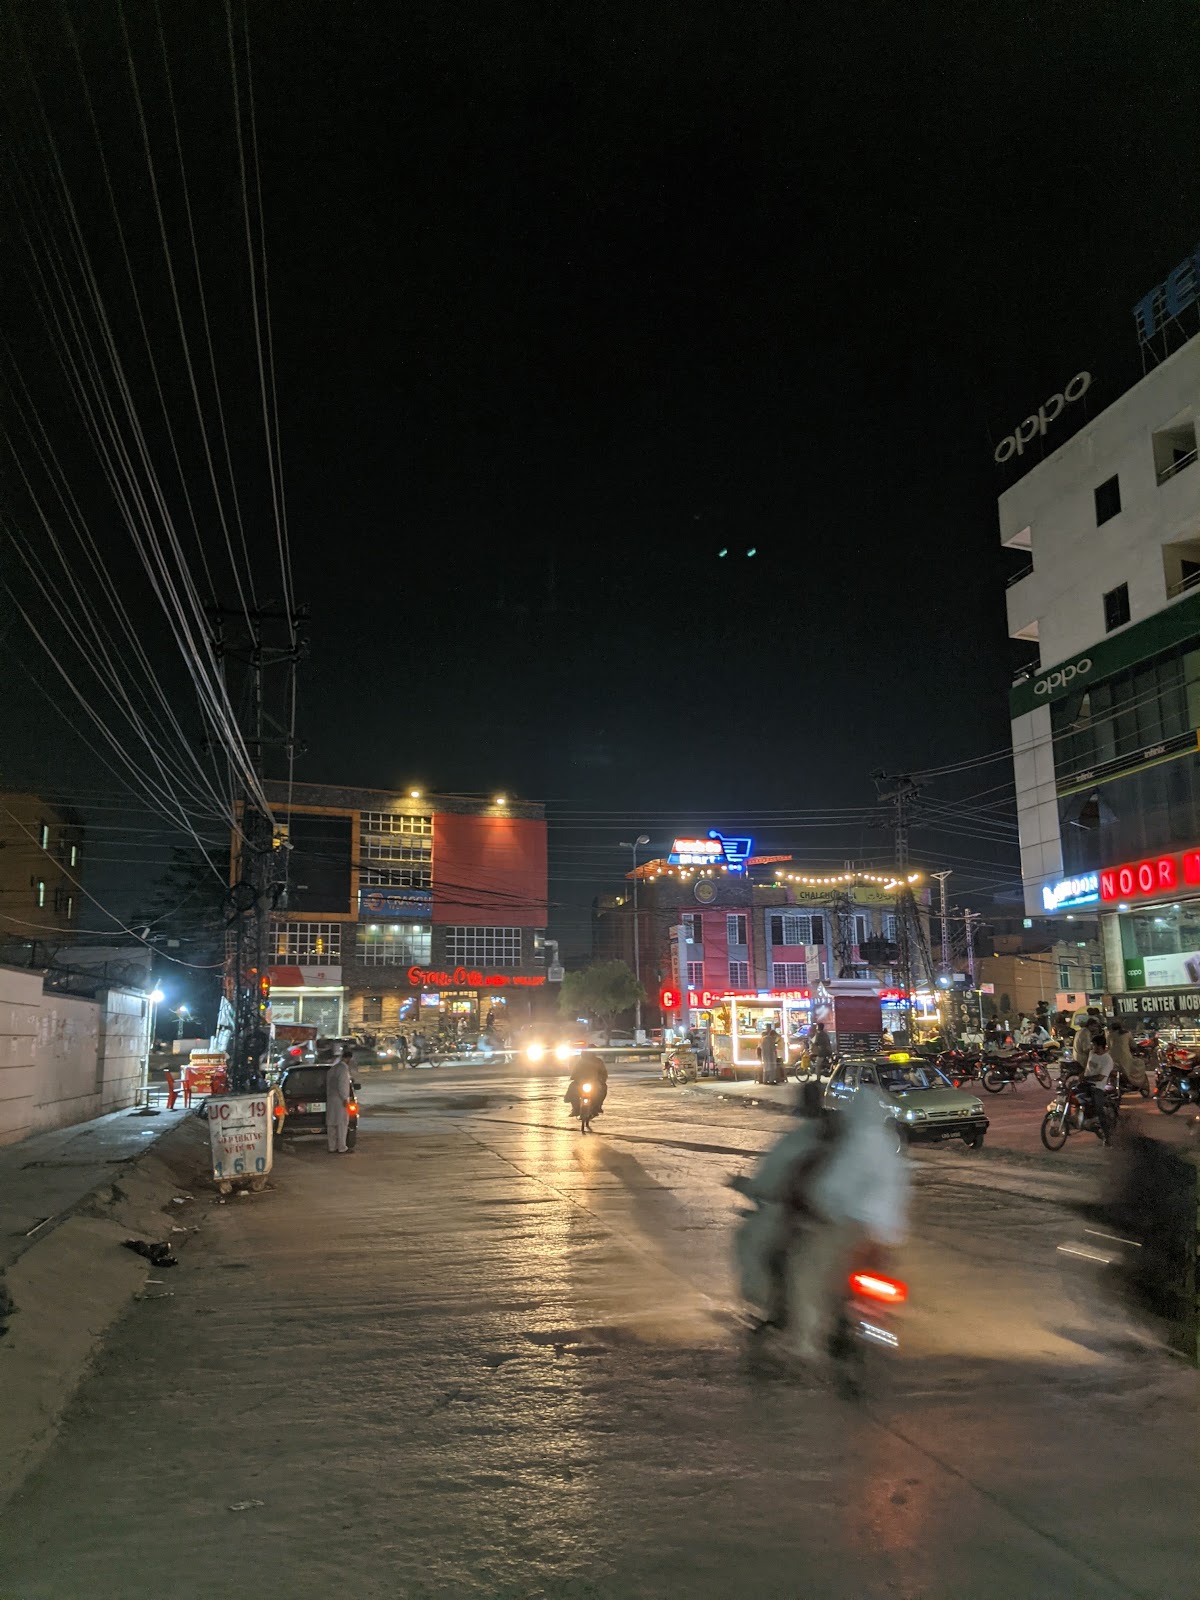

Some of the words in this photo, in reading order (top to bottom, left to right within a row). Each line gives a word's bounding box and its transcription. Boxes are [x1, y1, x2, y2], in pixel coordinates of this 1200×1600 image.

[994, 371, 1092, 462] oppo
[1033, 658, 1093, 695] oppo
[1101, 860, 1171, 898] NOOR
[1118, 998, 1138, 1013] TIME
[1141, 996, 1175, 1012] CENTER
[1178, 995, 1200, 1011] MOB
[209, 1103, 230, 1120] UC
[248, 1101, 266, 1118] 19
